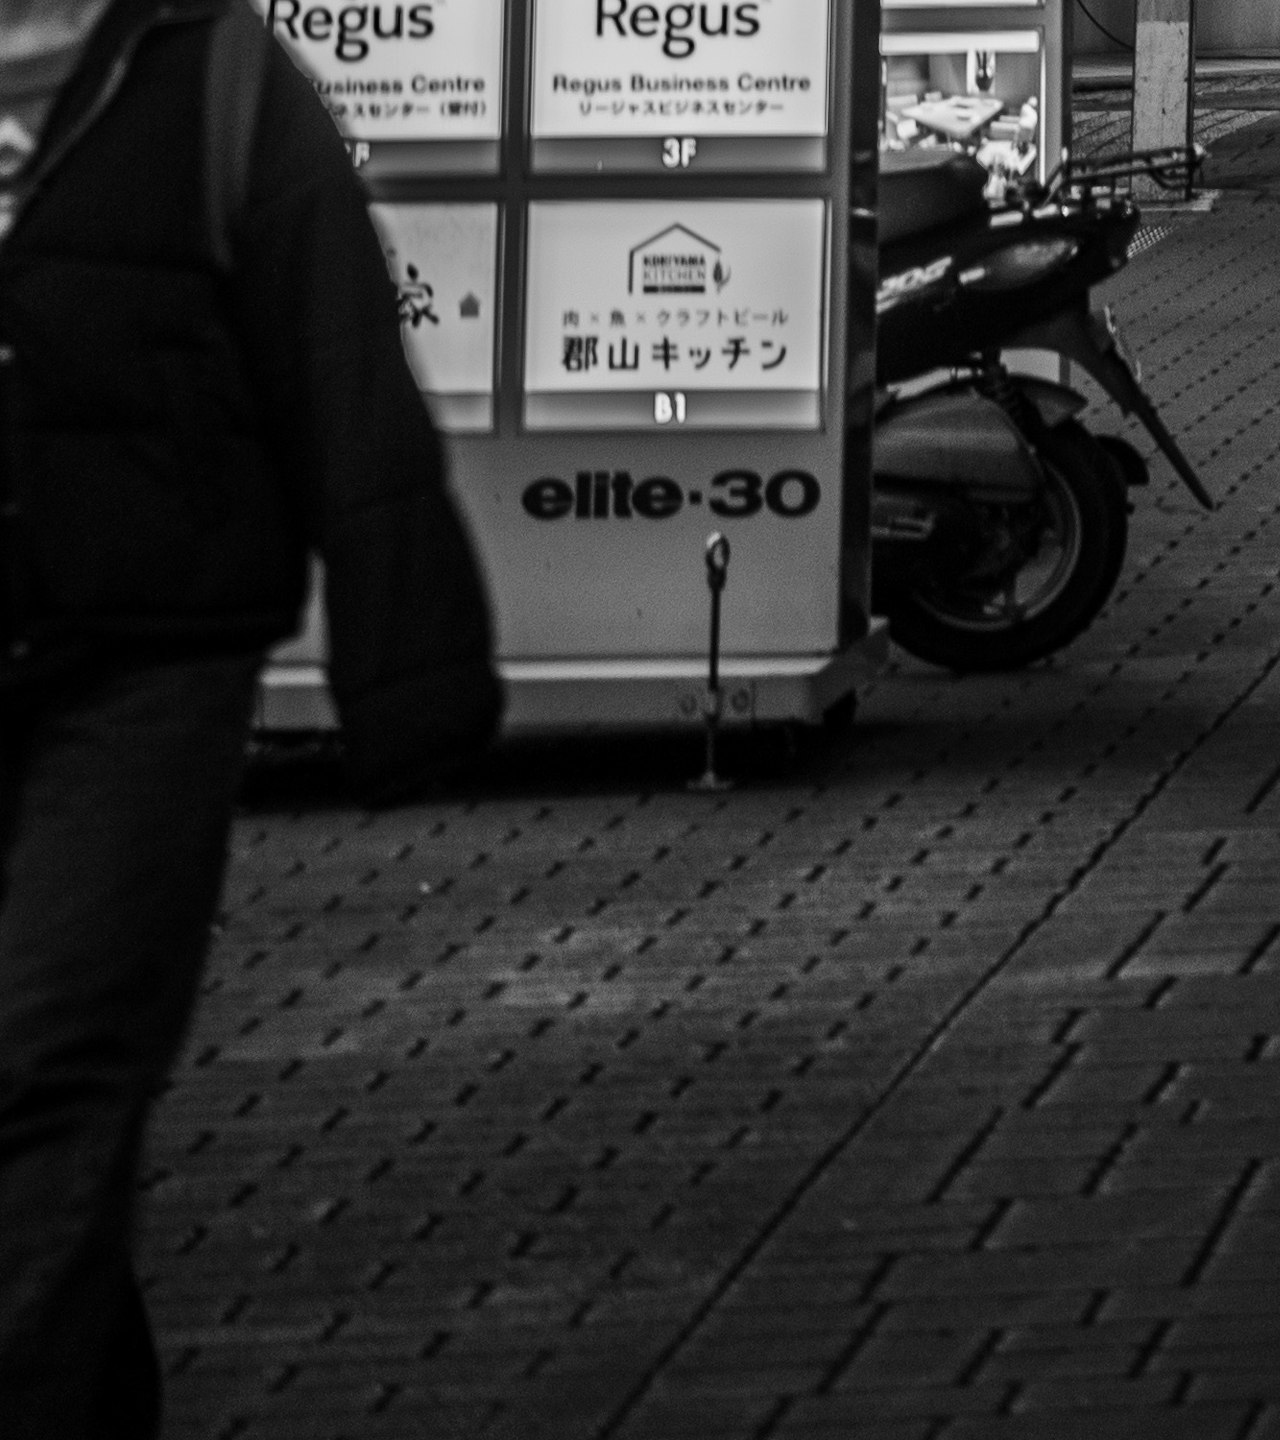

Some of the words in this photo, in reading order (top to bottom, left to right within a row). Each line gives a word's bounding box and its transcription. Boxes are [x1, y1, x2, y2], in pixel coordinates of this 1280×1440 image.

[316, 75, 404, 96] usiness
[410, 74, 486, 95] Centre
[552, 73, 623, 96] Regus
[630, 73, 730, 92] Business
[737, 73, 812, 92] Centre
[662, 137, 697, 168] 3F
[642, 254, 706, 267] KORIYAMA
[642, 268, 706, 281] KITCHEN
[562, 333, 788, 372] 郡山キッチン
[652, 391, 687, 424] B1
